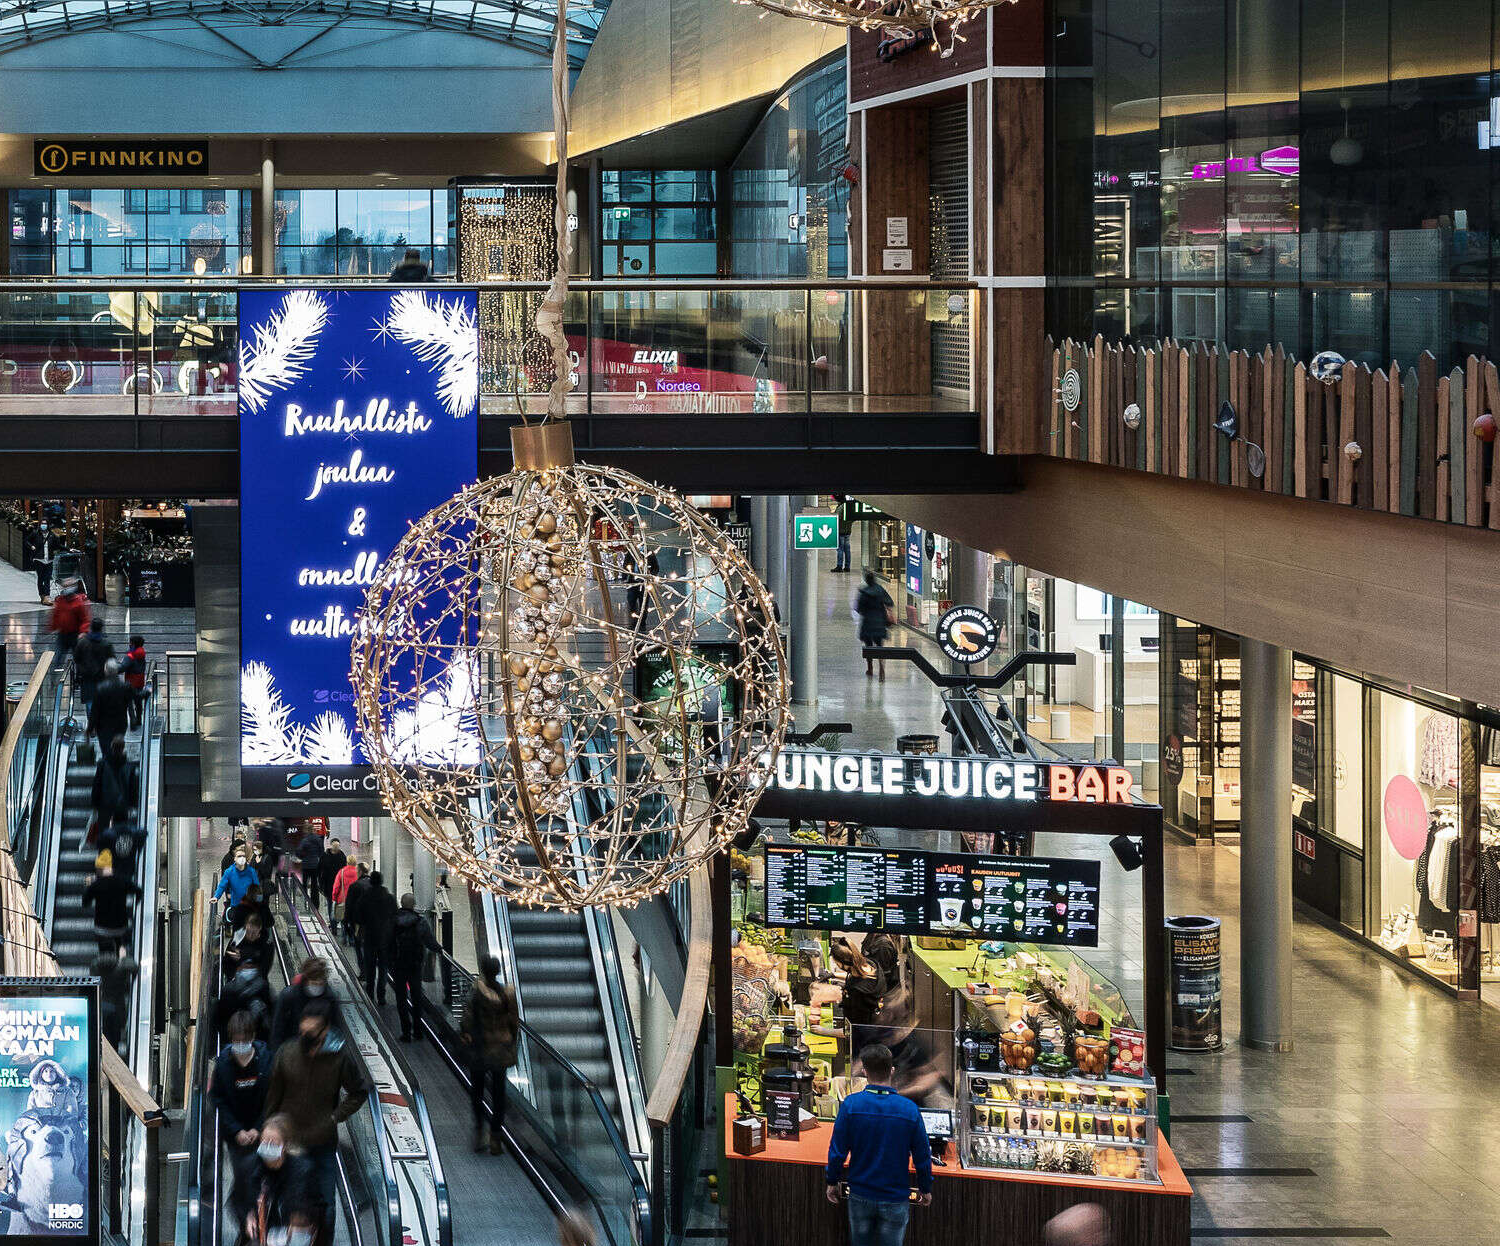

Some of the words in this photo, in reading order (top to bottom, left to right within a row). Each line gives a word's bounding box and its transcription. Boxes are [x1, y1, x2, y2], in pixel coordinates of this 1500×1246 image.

[71, 149, 204, 167] FINNKINO
[633, 351, 678, 363] ELIXIA
[656, 380, 700, 392] Nordea
[285, 399, 432, 436] Rauhallista
[305, 450, 395, 500] joulua
[348, 508, 366, 536] &
[653, 669, 675, 688] TUE
[313, 775, 360, 791] Clear
[915, 759, 1036, 800] JUICE
[1050, 766, 1134, 804] BAR
[0, 1010, 65, 1025] MINUT
[49, 1204, 83, 1218] HBO
[49, 1221, 83, 1229] NORDIC
